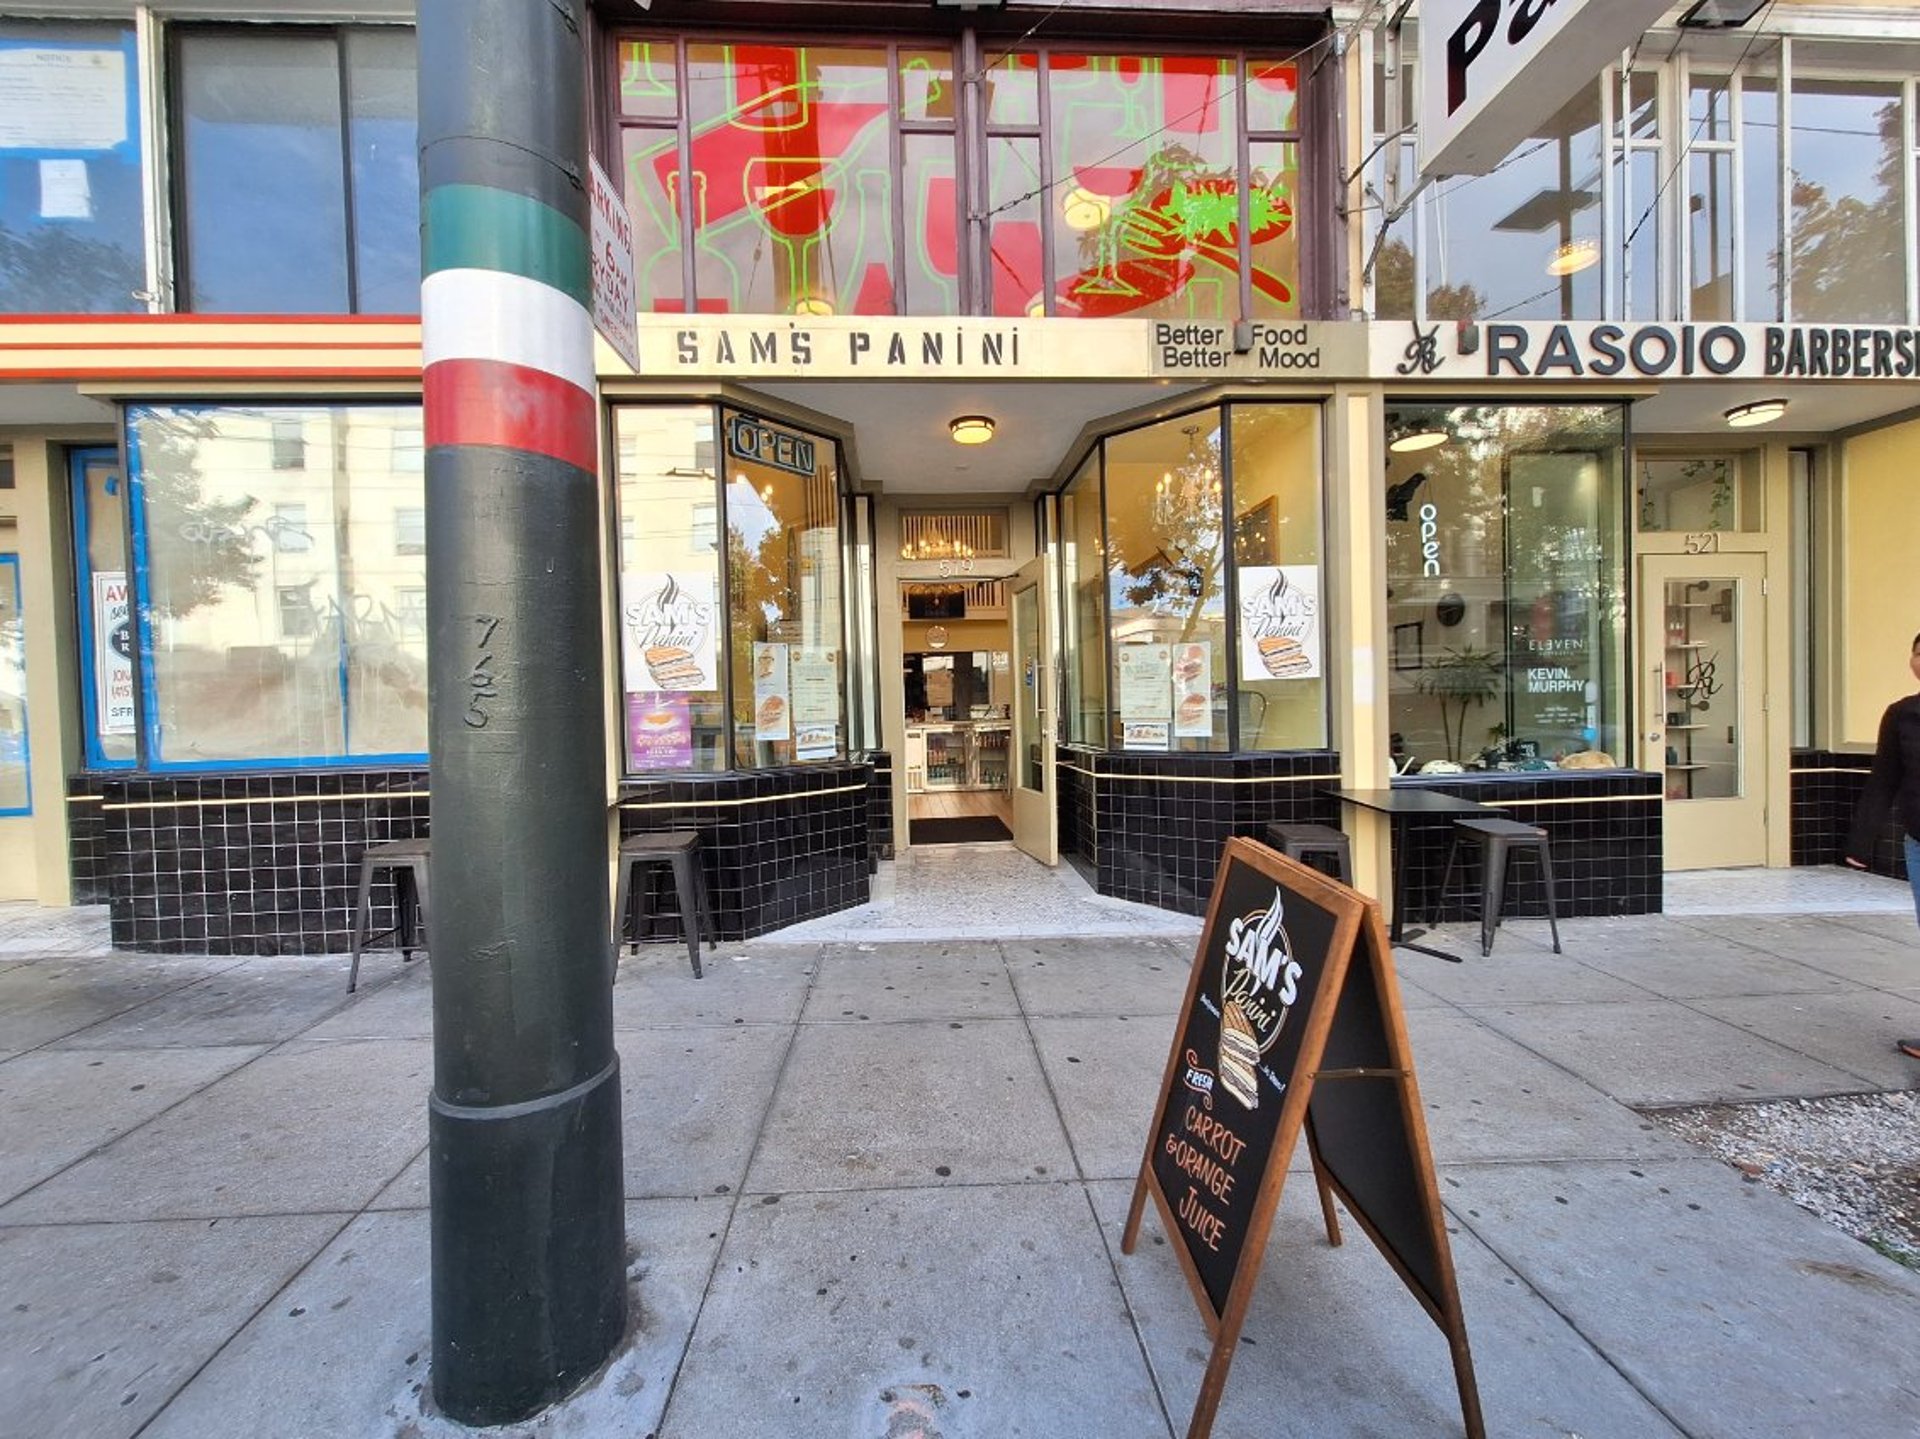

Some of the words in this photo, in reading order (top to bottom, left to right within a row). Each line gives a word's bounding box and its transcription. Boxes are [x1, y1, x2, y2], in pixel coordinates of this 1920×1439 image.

[1156, 324, 1224, 346] Better
[1252, 324, 1308, 346] Food
[1163, 346, 1231, 368] Better
[1259, 347, 1321, 369] Mood
[1487, 325, 1746, 376] RASOIO
[738, 424, 813, 471] OPEN
[1684, 532, 1721, 554] 521
[626, 602, 714, 626] SAM'S
[1242, 594, 1316, 618] SAM'S
[638, 624, 697, 649] Panini
[1252, 614, 1305, 639] Panini
[1528, 680, 1584, 693] MURPHY
[1225, 917, 1303, 1006] SAM'S
[1223, 968, 1279, 1033] Panini
[1185, 1105, 1247, 1167] CARROT
[1179, 1186, 1227, 1252] JUICE
